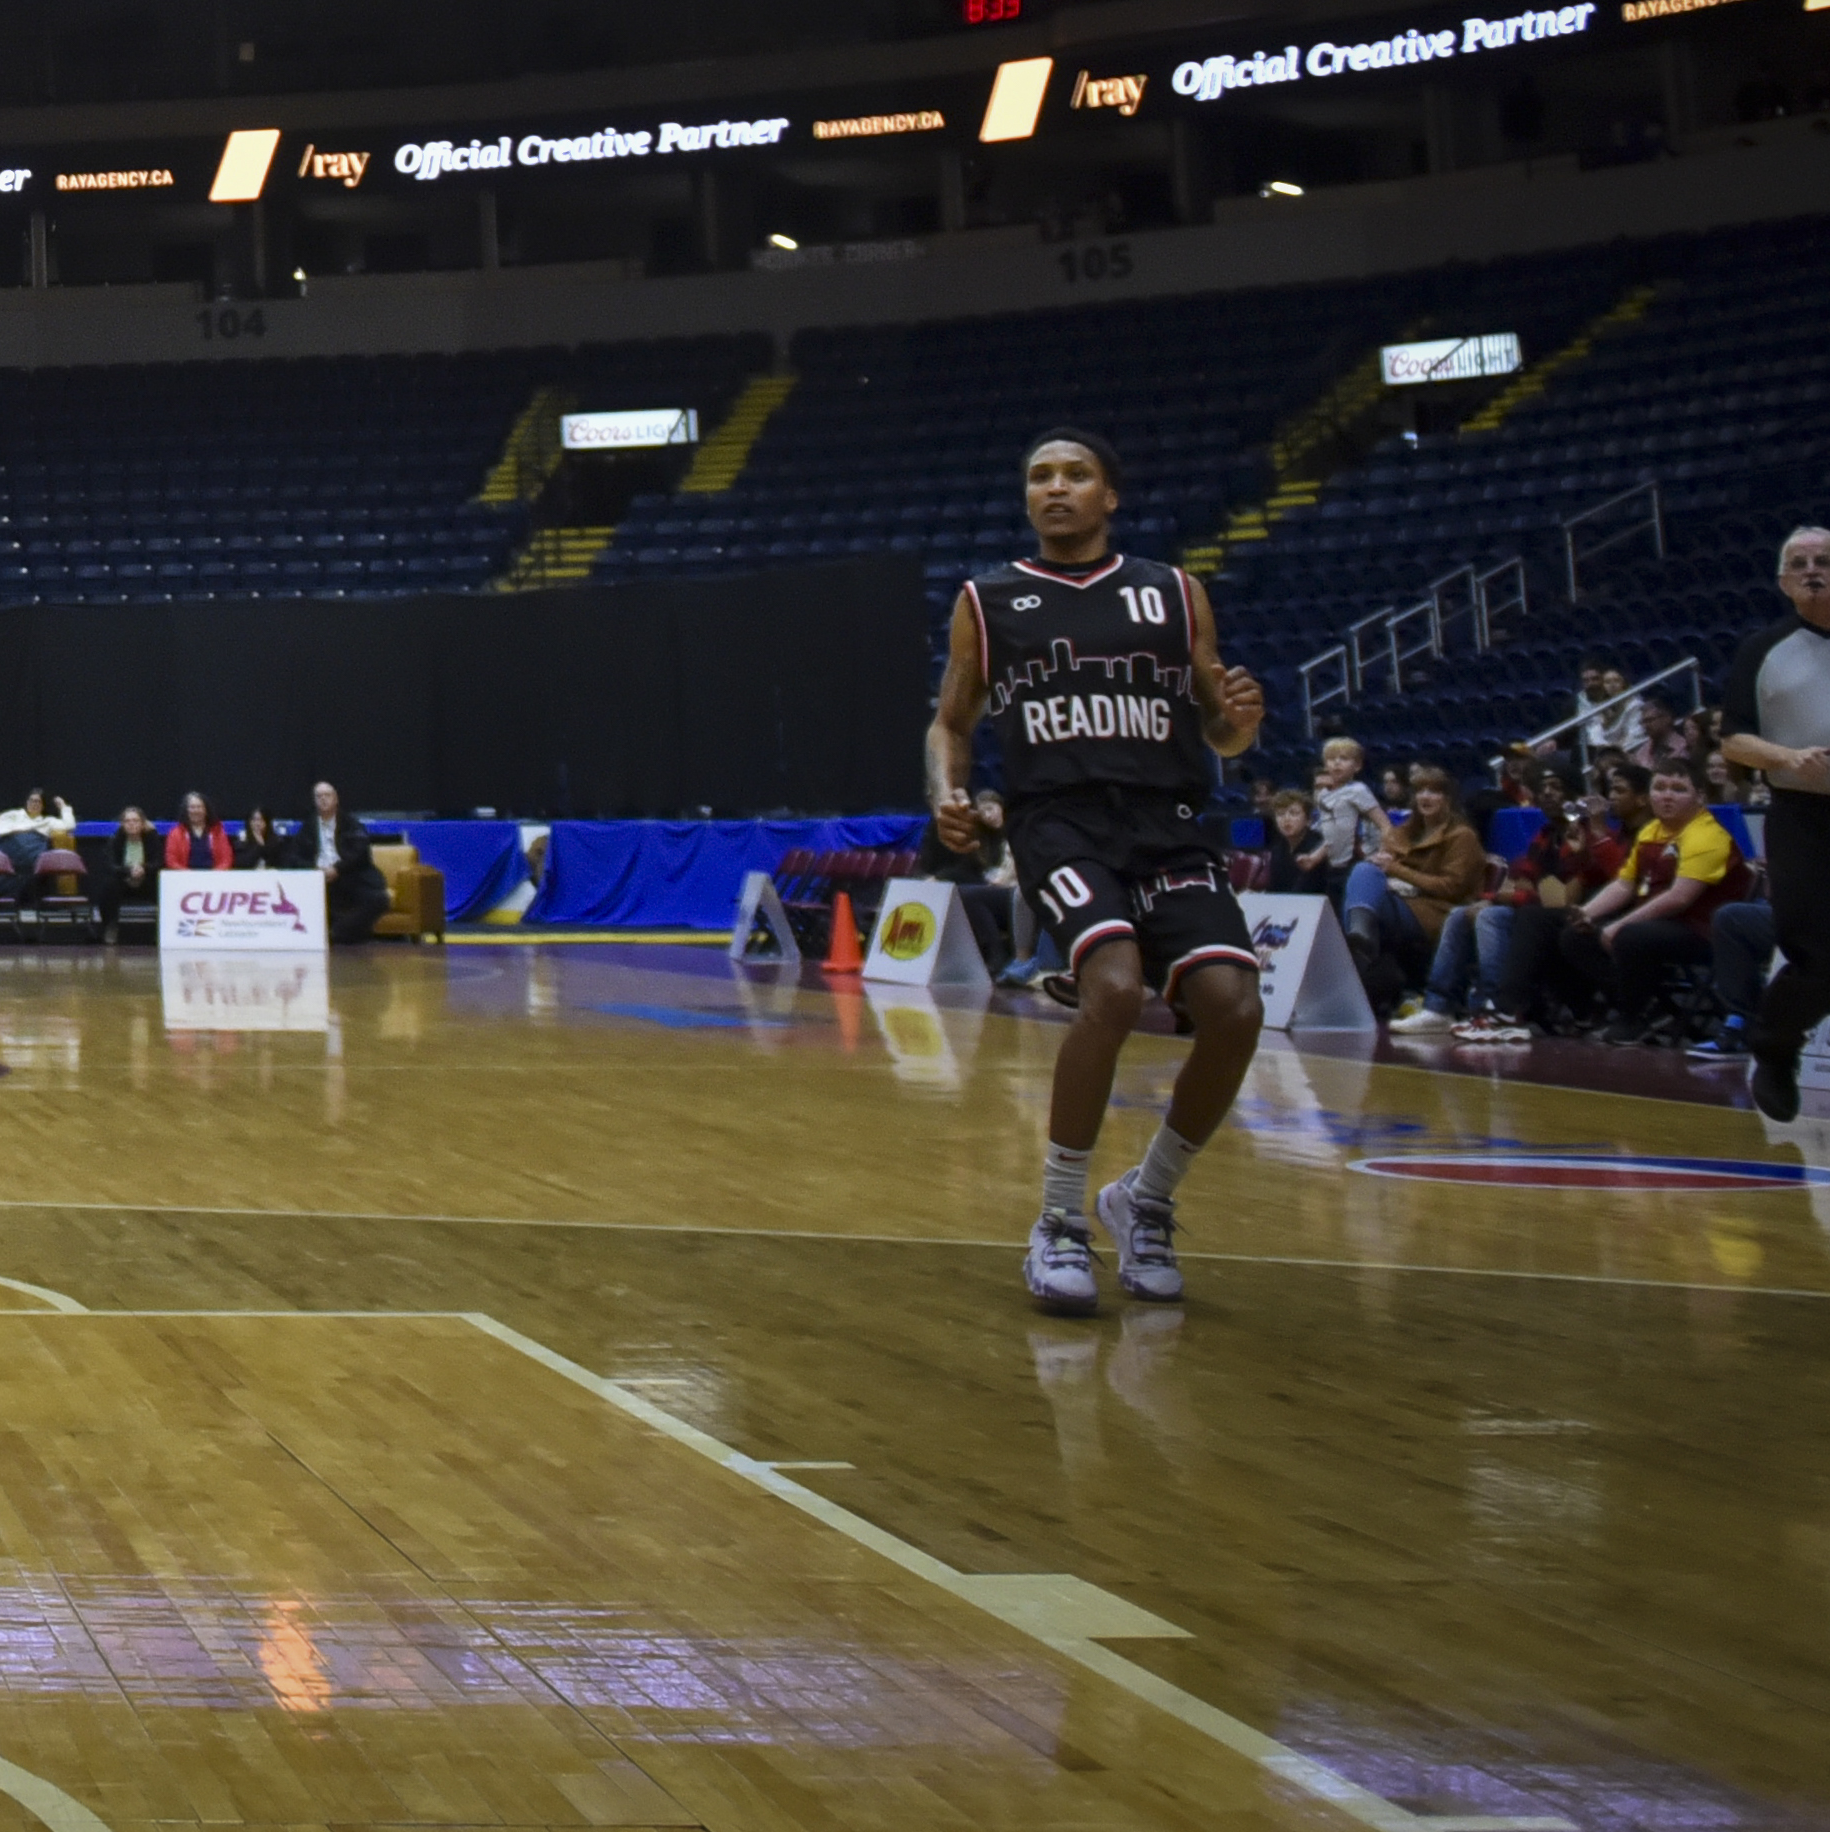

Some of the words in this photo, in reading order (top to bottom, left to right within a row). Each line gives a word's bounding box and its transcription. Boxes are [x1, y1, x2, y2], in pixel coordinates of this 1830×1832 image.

[1171, 45, 1301, 102] Official
[1305, 28, 1457, 77] Creative
[1460, 2, 1596, 53] Partner
[394, 139, 513, 181] Official
[516, 127, 653, 166] Creative
[655, 117, 790, 154] Partner
[1059, 242, 1133, 284] 105
[195, 308, 267, 341] 104
[569, 419, 631, 443] Coors
[1118, 585, 1167, 625] 10
[1023, 695, 1173, 745] READING
[179, 891, 271, 915] CUPE
